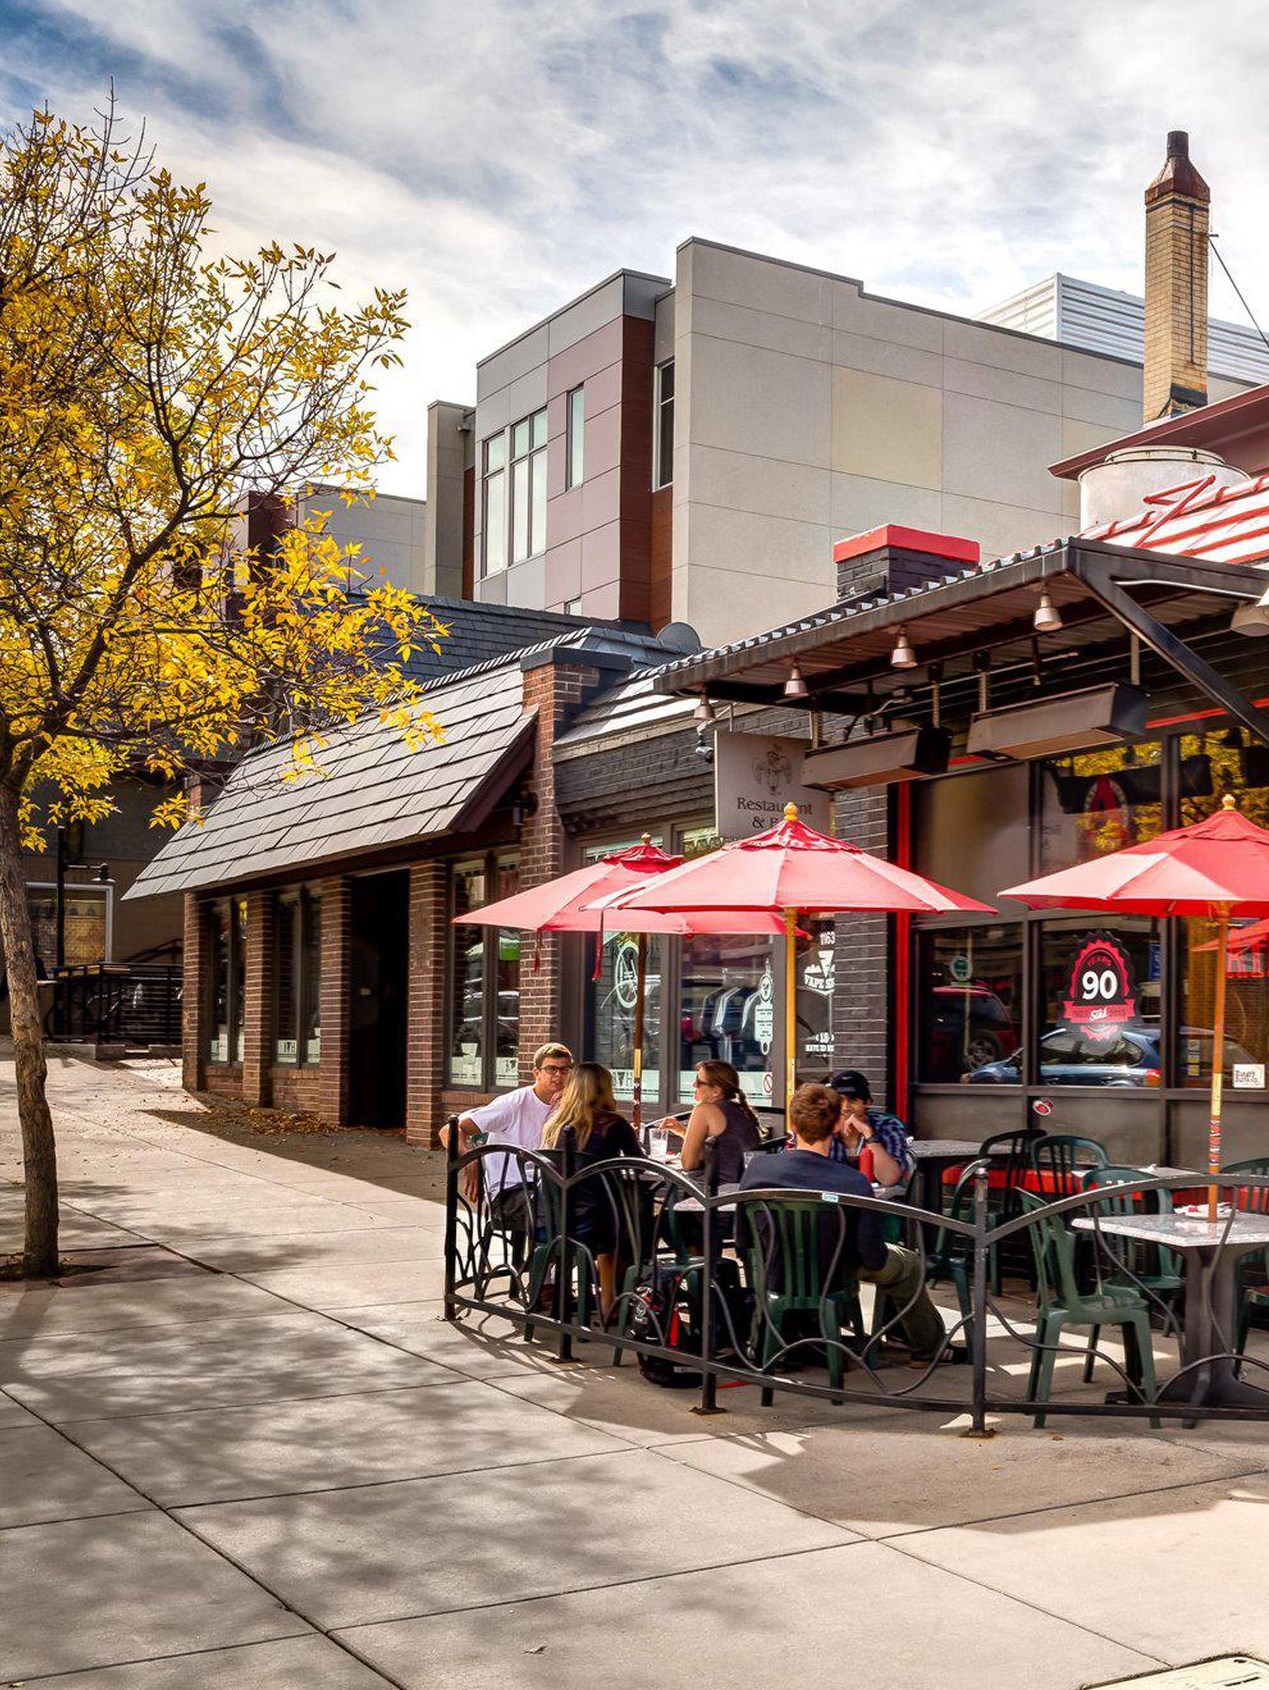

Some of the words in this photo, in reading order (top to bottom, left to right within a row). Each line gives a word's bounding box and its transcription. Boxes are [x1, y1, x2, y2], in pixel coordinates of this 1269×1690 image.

[737, 797, 813, 815] Restaunt
[752, 815, 765, 829] &
[1082, 969, 1118, 1000] 90
